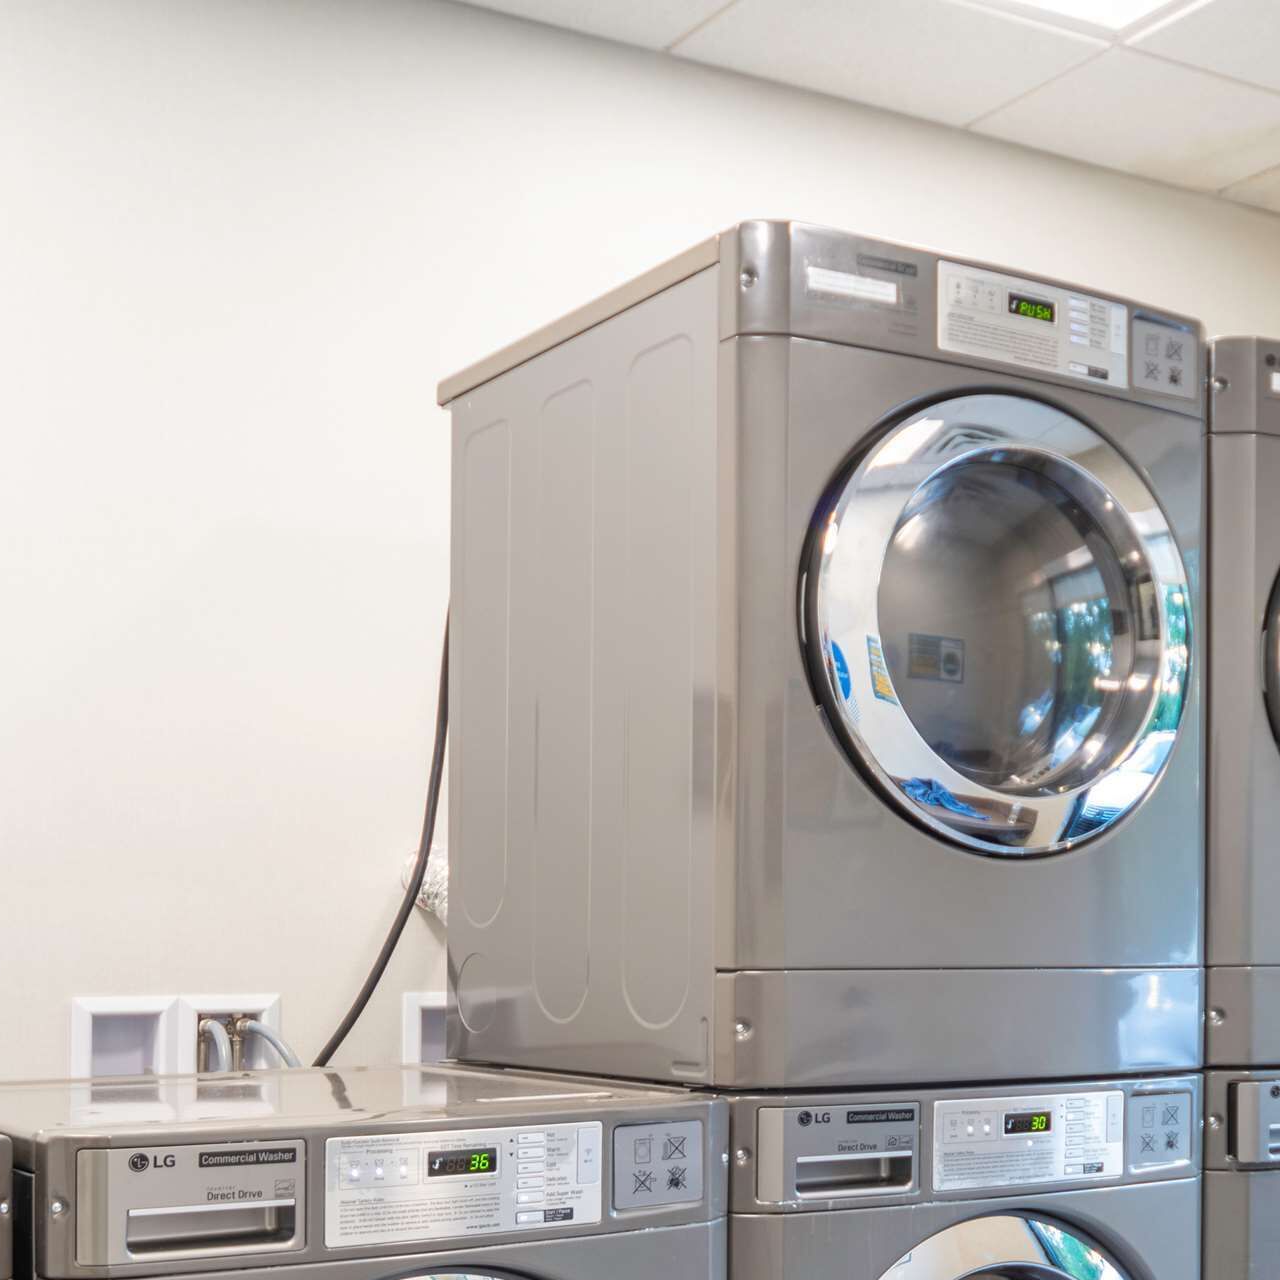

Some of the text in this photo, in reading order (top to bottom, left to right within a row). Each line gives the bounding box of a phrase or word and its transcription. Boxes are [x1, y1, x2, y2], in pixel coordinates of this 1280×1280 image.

[815, 1110, 912, 1124] LG Commercial Washer
[1031, 1116, 1046, 1129] 30
[838, 1142, 877, 1152] Direct Drive
[153, 1151, 293, 1168] LG Commercial Washer
[470, 1153, 489, 1170] 36
[207, 1189, 262, 1201] Direct Drive
